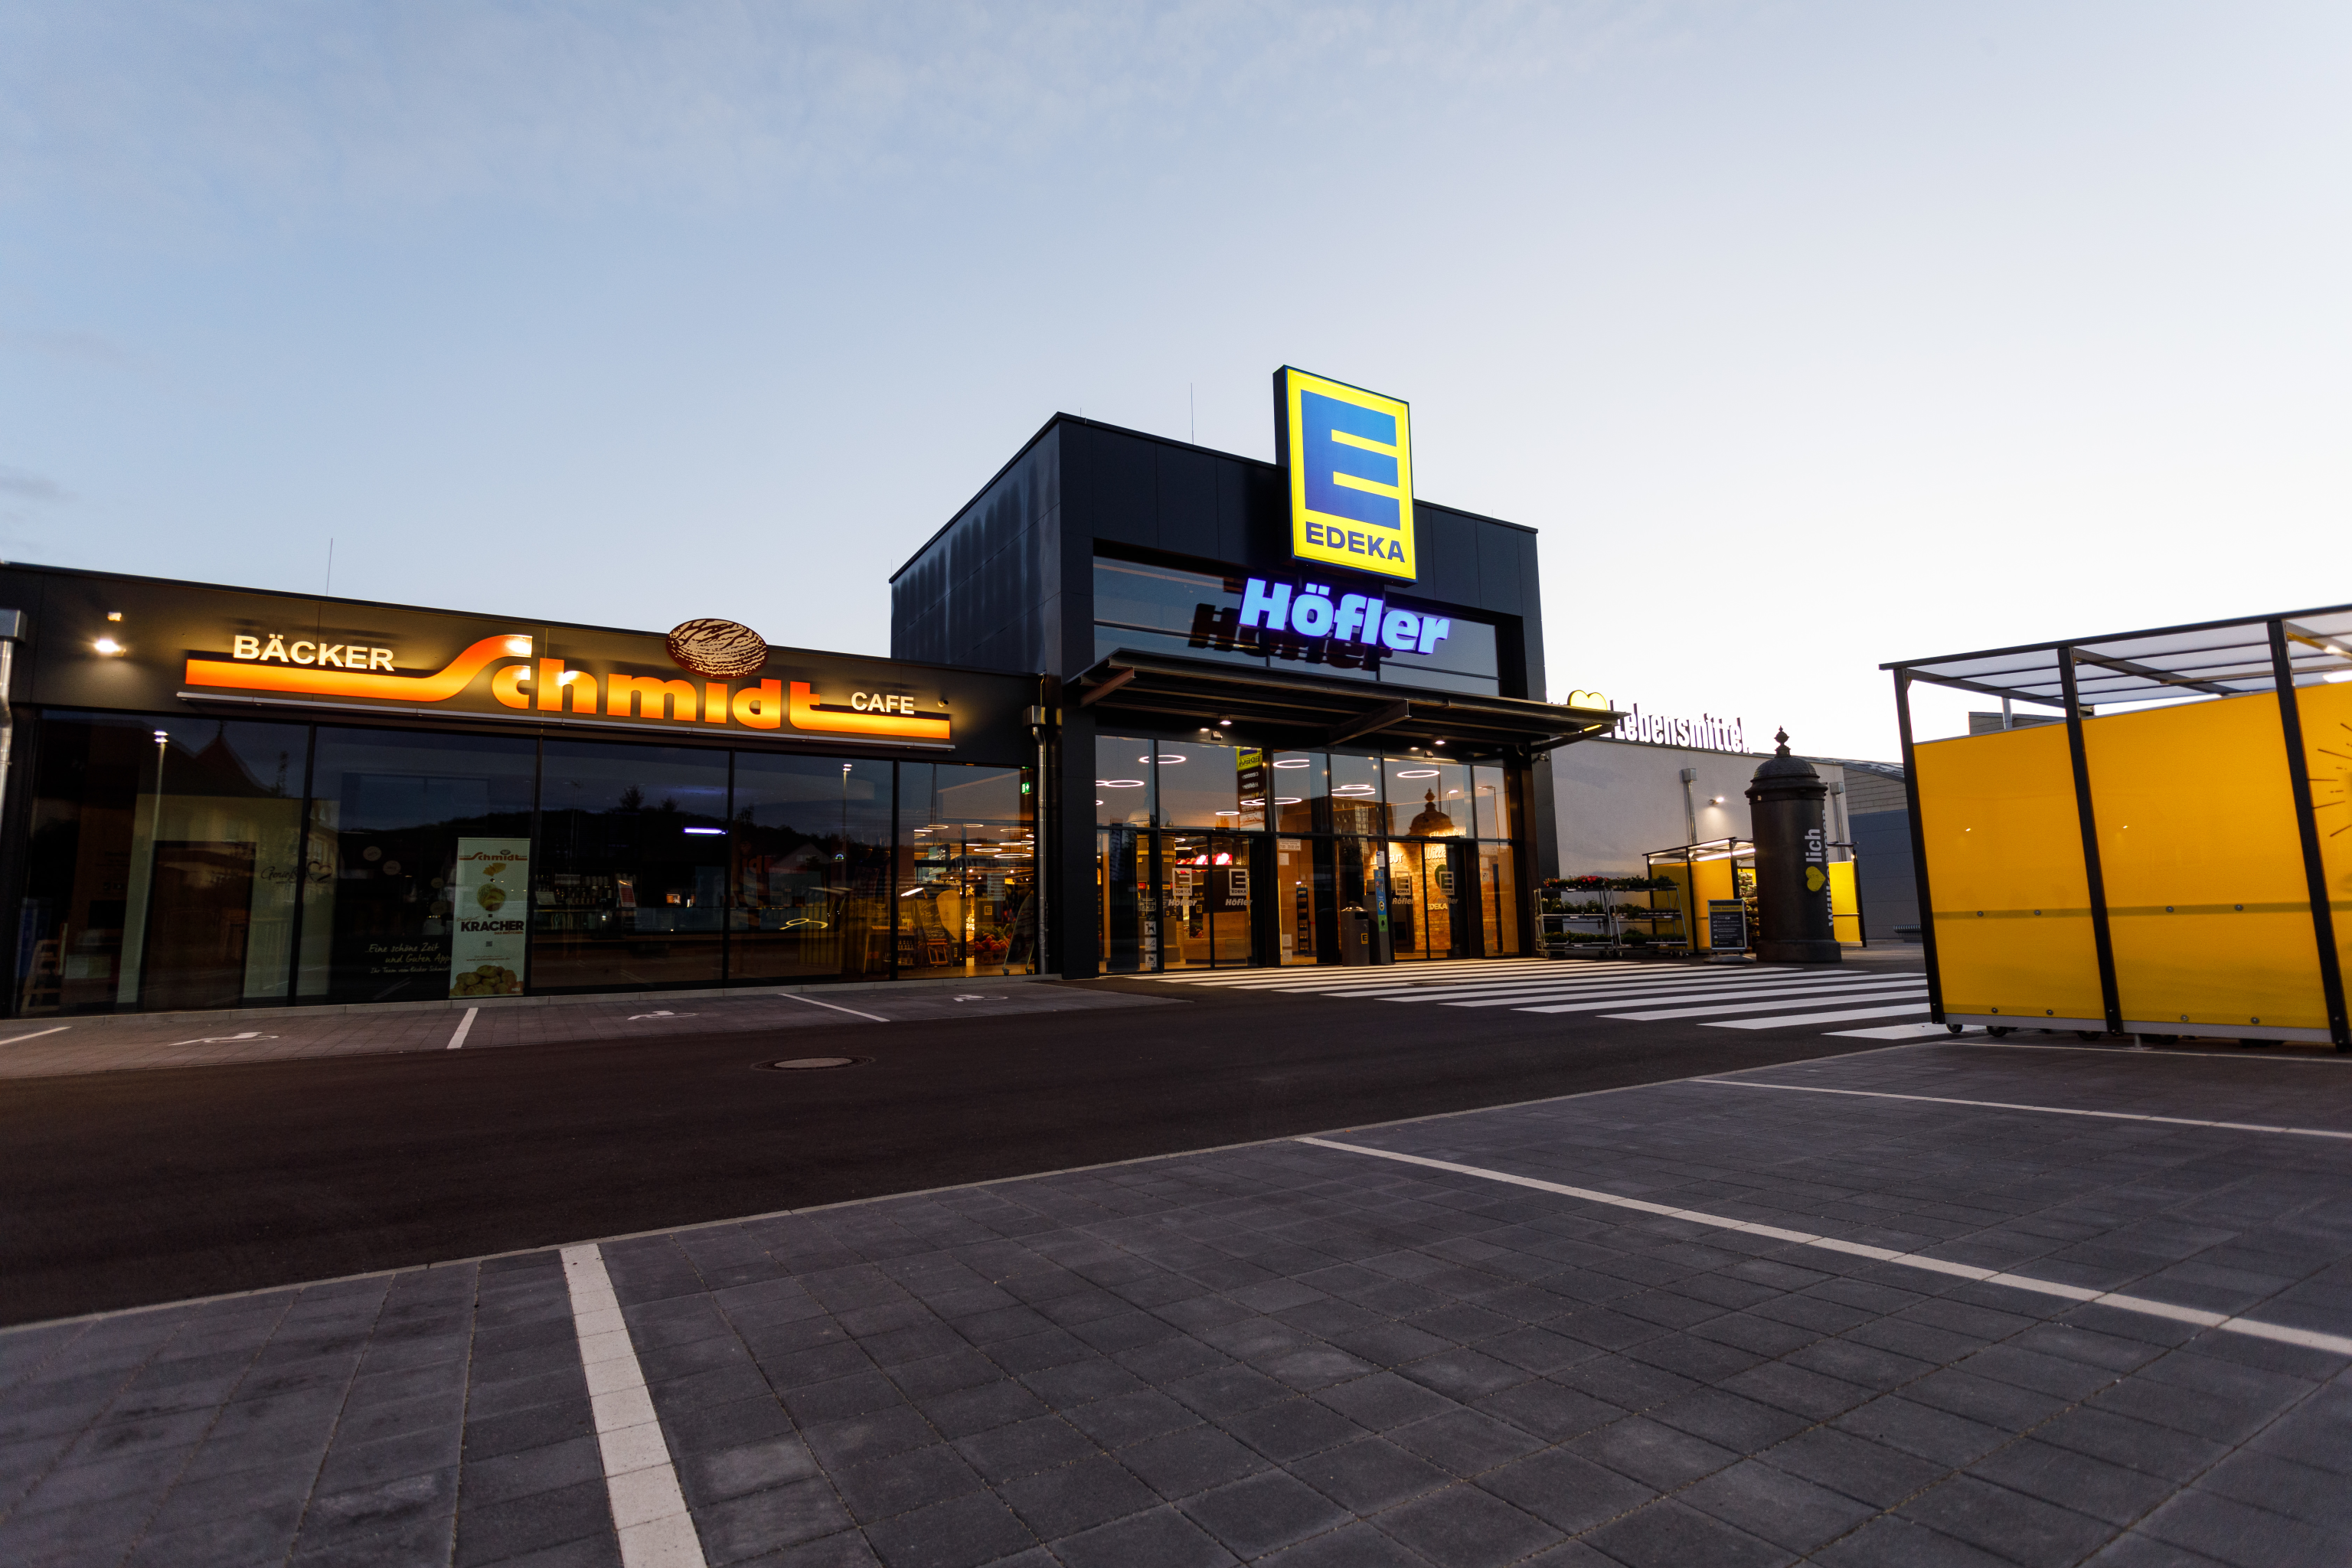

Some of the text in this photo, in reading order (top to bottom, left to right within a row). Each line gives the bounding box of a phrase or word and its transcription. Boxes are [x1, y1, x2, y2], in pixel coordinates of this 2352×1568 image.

[1301, 389, 1400, 531] E
[1305, 521, 1405, 564] EDEKA
[1238, 577, 1450, 655] Höfler
[233, 634, 394, 671] BÄCKER
[851, 691, 915, 715] CAFE
[459, 851, 528, 861] Schmidt
[1805, 828, 1822, 862] lich
[1225, 898, 1253, 906] Höfler
[461, 920, 524, 932] KRACHER
[385, 952, 452, 964] und Guten App
[390, 942, 418, 952] schöne
[420, 942, 439, 952] Zeit
